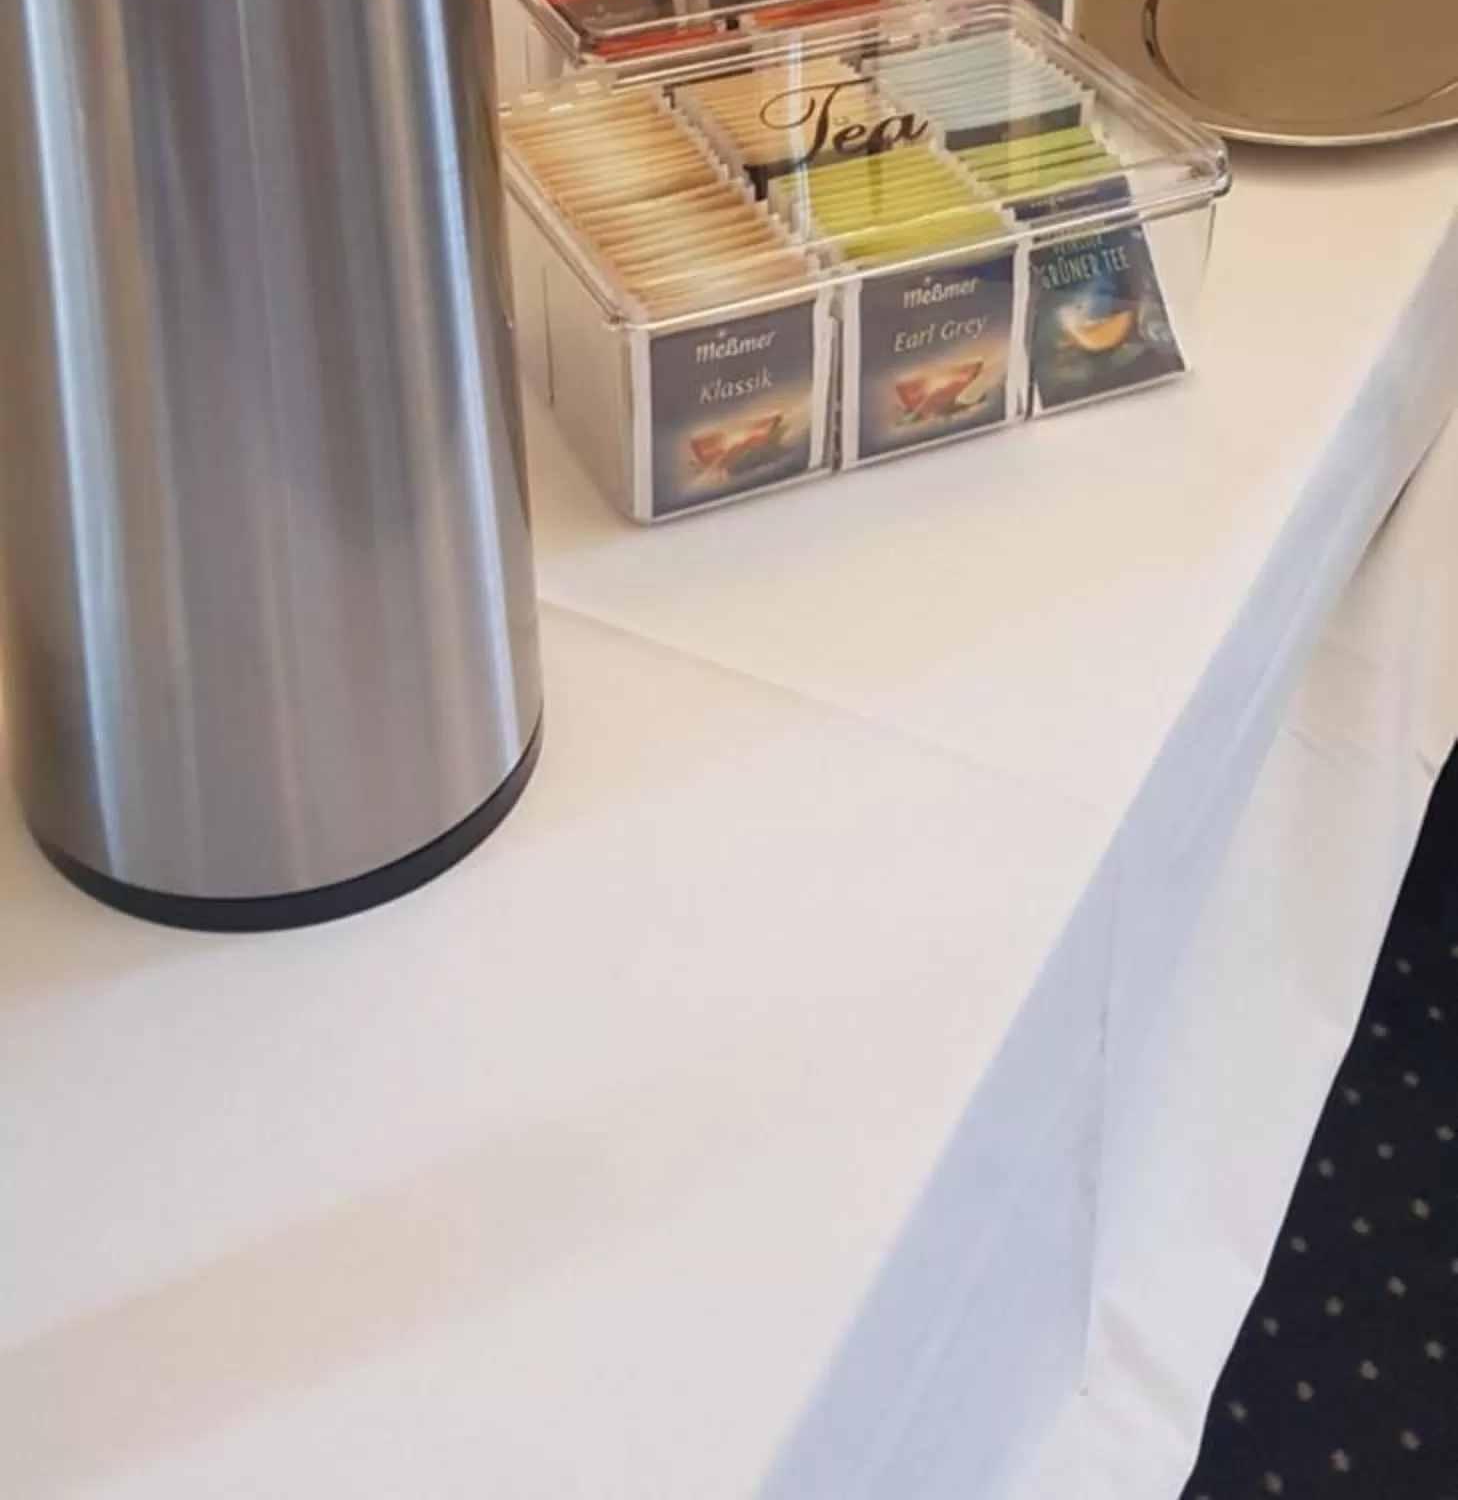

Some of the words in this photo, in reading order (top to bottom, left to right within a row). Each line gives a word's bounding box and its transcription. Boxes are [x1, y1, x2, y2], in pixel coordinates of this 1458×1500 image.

[759, 75, 929, 166] Tea
[894, 323, 935, 352] Earl
[940, 316, 988, 340] Grey
[700, 366, 772, 404] Klassik
